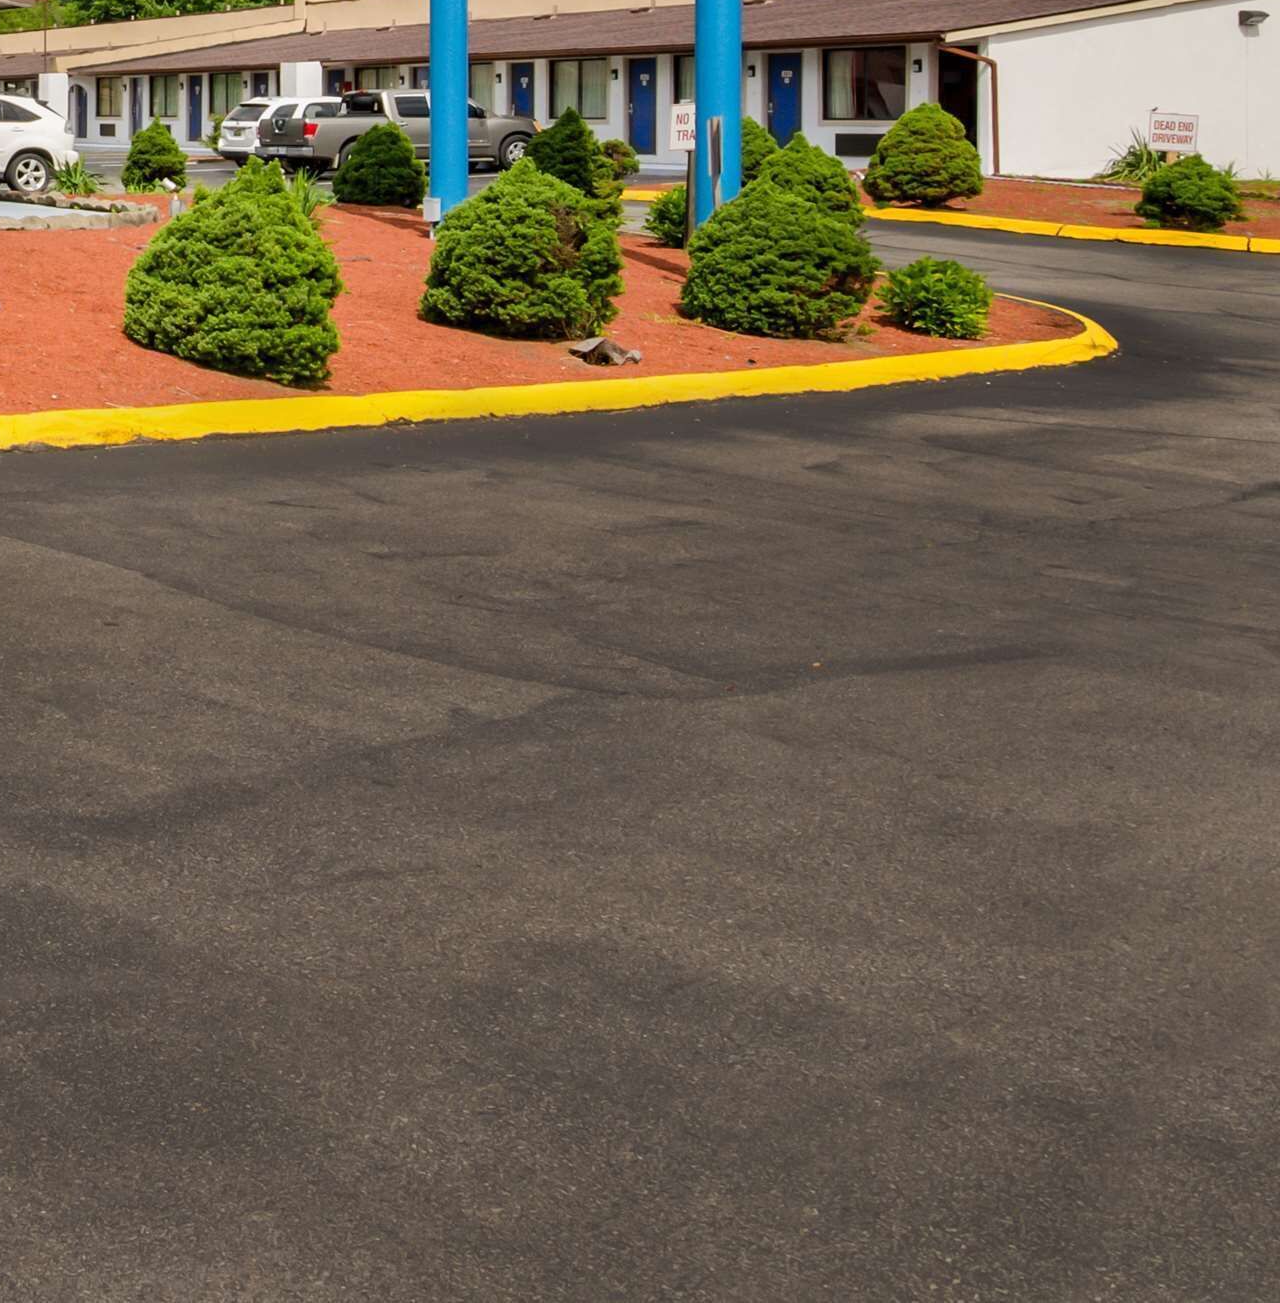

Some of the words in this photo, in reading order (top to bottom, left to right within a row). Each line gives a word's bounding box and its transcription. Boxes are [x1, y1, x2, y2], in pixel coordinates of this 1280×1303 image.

[676, 112, 690, 125] NO
[1153, 119, 1176, 132] DEAD
[1177, 120, 1194, 133] END
[676, 129, 696, 142] TRA
[1151, 132, 1194, 145] DRIVEWAY
